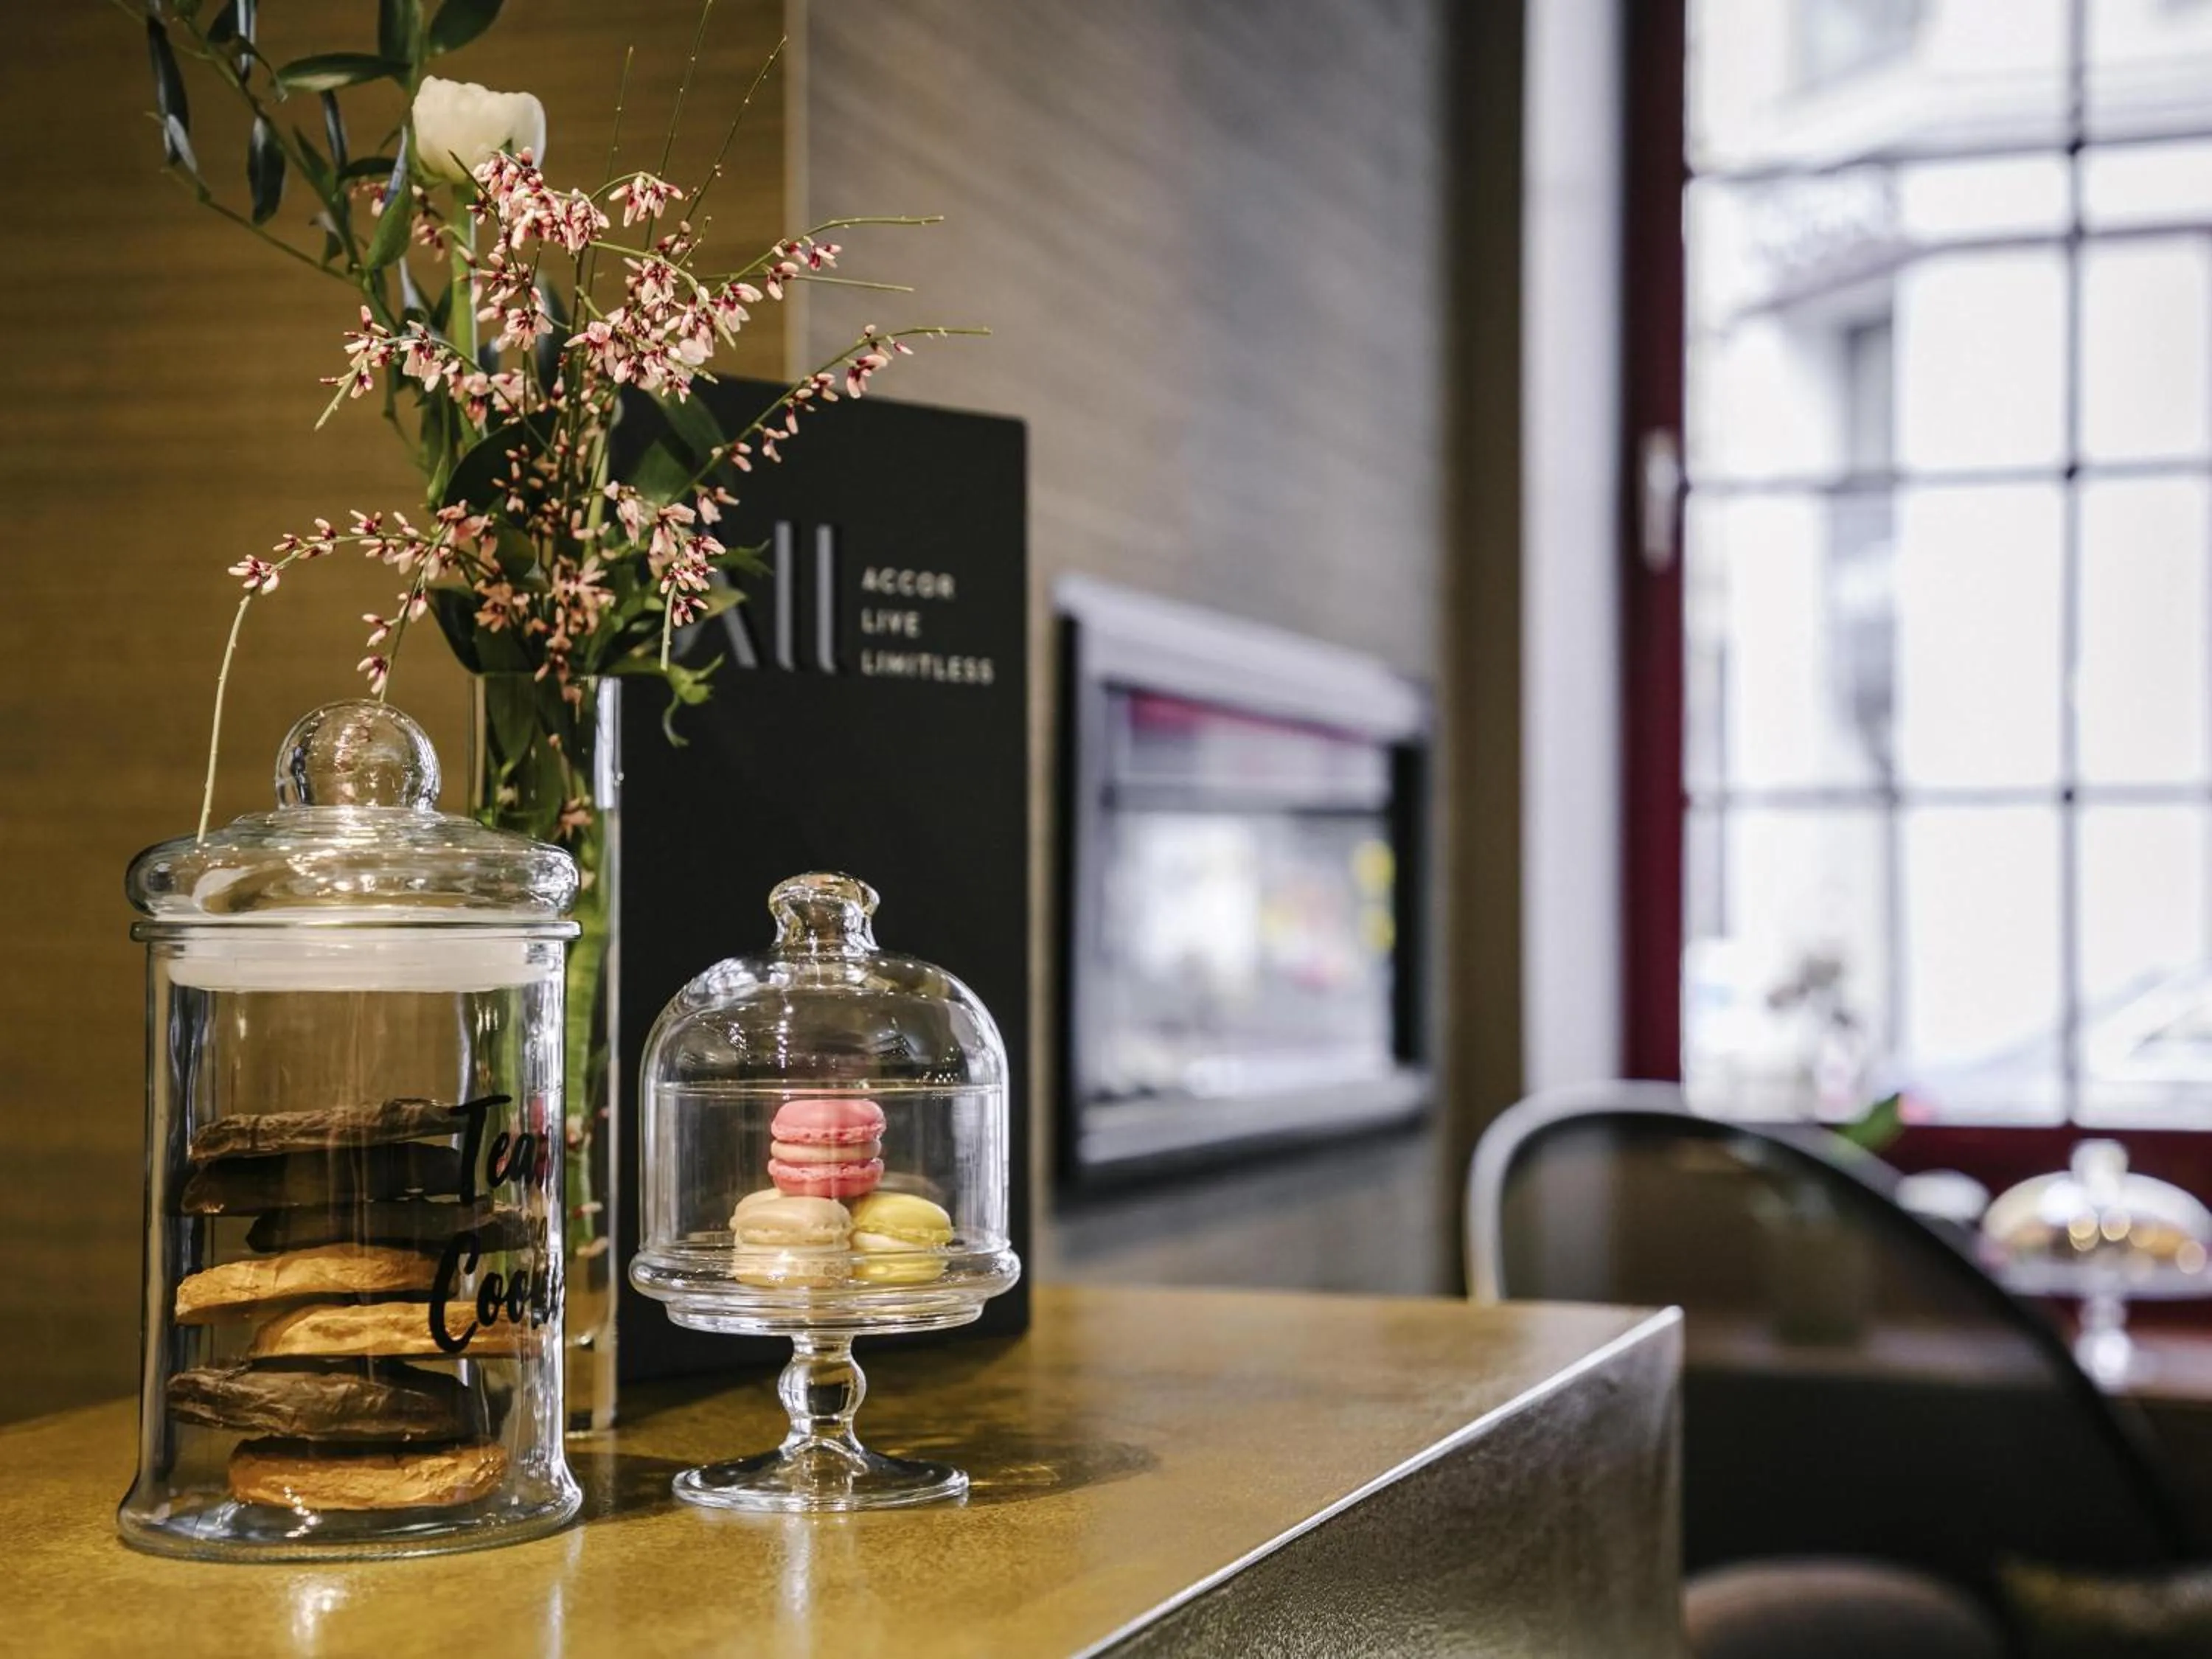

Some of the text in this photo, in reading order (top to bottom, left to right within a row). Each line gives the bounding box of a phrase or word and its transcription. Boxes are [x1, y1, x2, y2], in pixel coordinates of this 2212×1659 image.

[860, 566, 956, 598] ACCOR
[860, 608, 920, 638] LIVE
[860, 649, 995, 684] LIMITLESS
